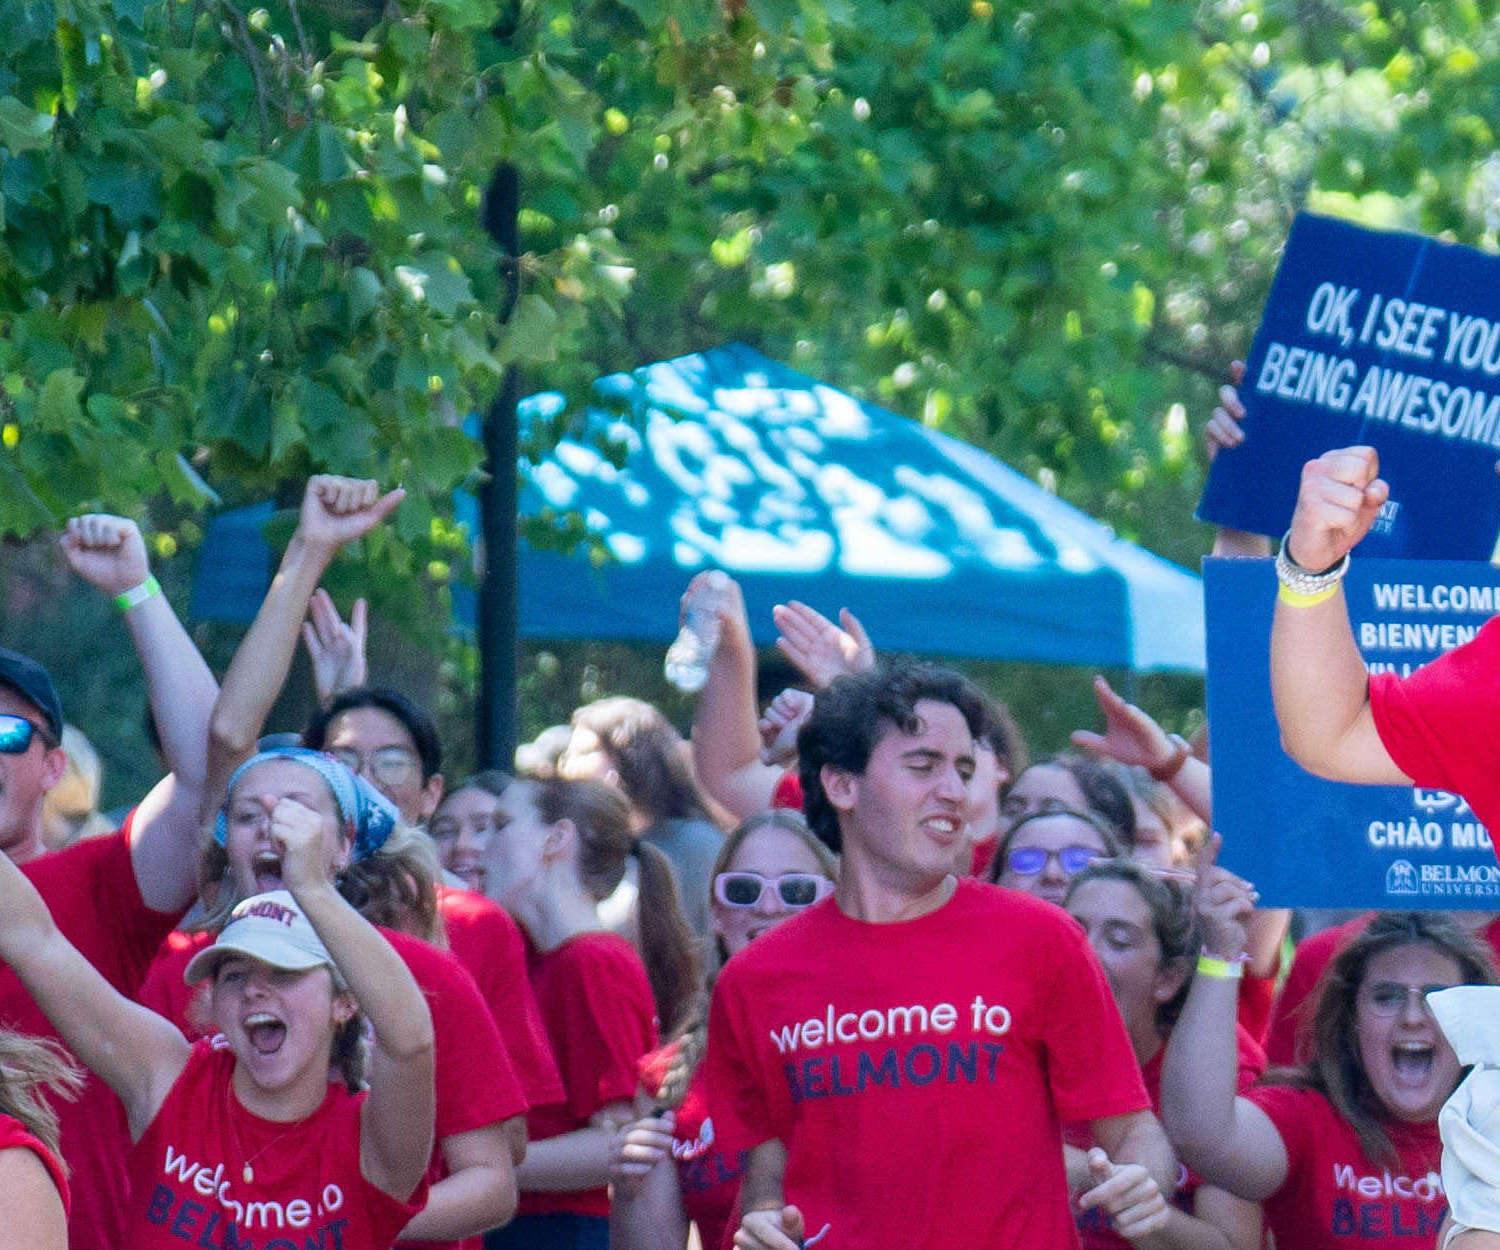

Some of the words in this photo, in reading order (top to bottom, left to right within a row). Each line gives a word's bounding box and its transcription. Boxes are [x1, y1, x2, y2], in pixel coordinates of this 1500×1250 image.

[1306, 282, 1360, 346] OK,
[1360, 293, 1382, 344] I
[1376, 297, 1446, 359] SEE
[1256, 341, 1358, 411] BEING
[1368, 816, 1444, 849] CHÀO
[238, 900, 298, 928] LMONT
[770, 1003, 958, 1054] welcome
[971, 995, 1012, 1037] to
[1332, 1162, 1443, 1202] welco
[1330, 1196, 1448, 1240] BELM
